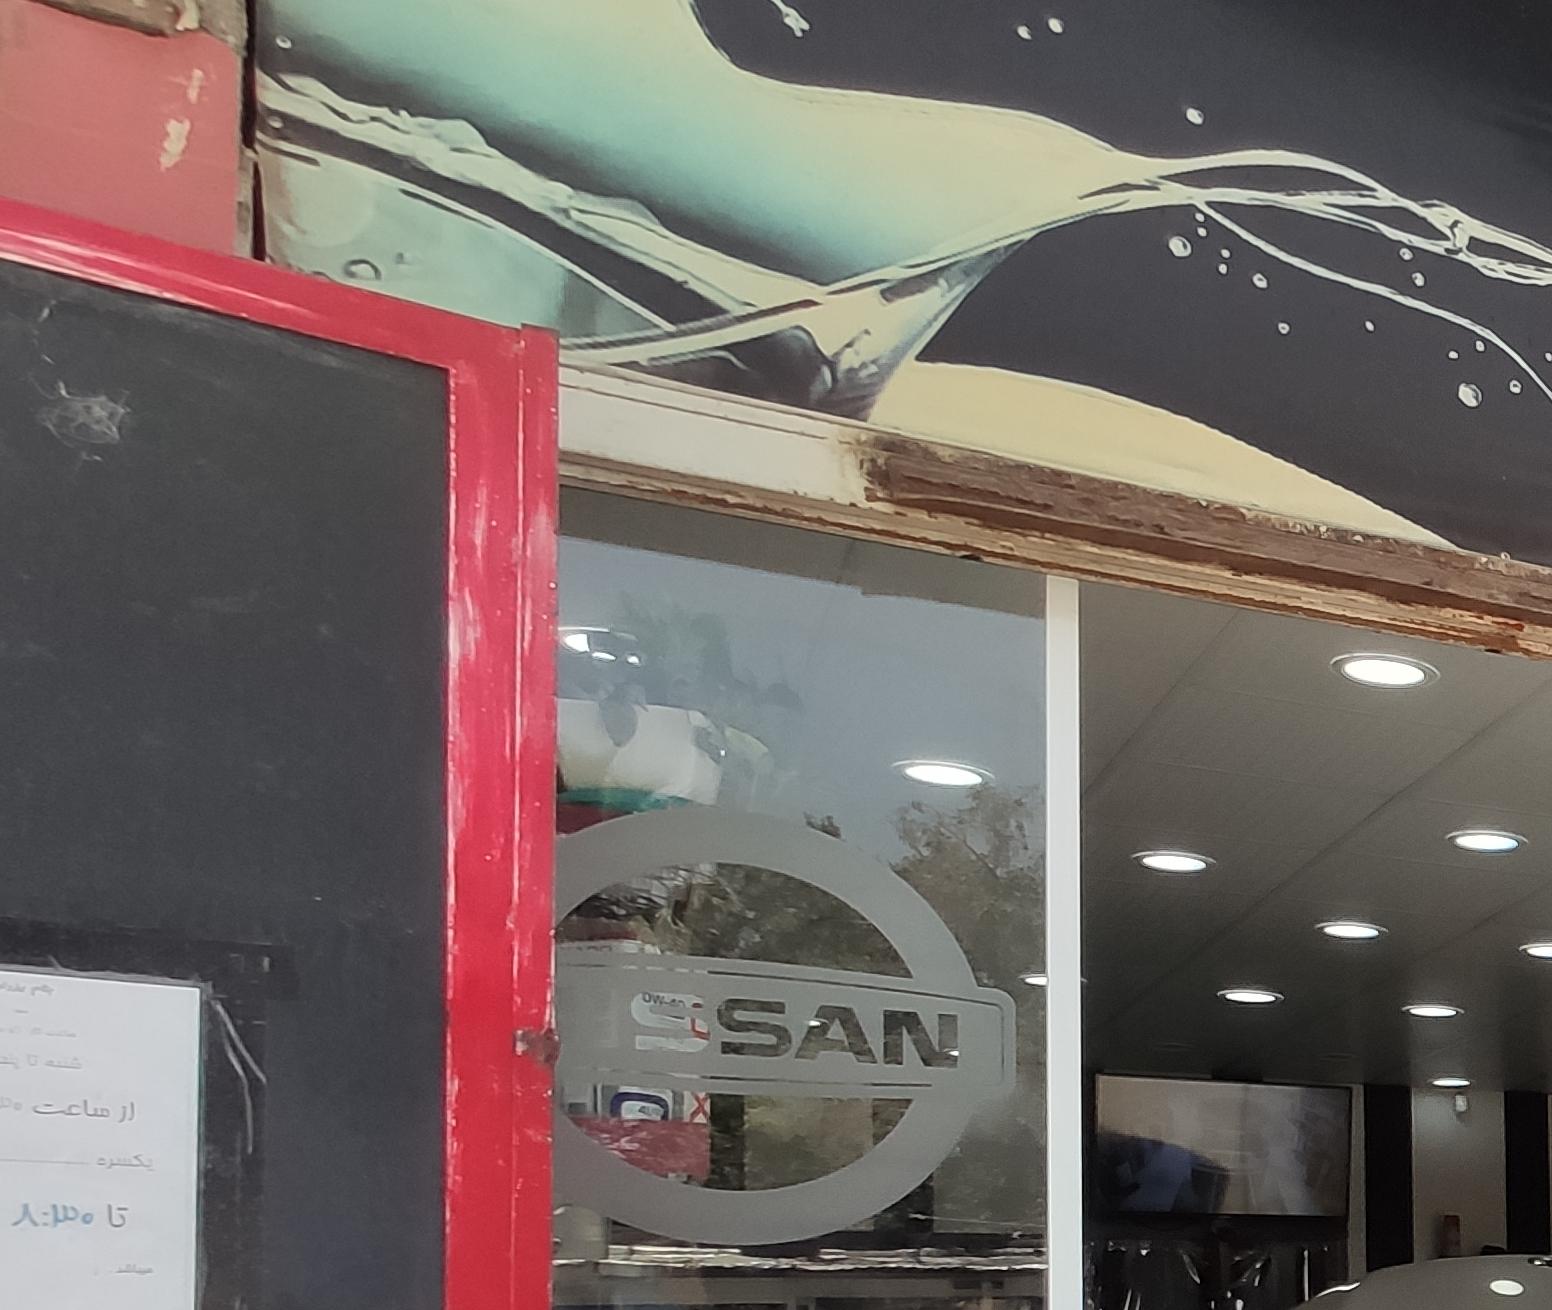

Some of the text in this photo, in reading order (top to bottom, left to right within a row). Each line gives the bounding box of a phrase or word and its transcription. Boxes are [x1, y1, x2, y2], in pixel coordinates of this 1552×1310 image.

[31, 1097, 112, 1120] ساعت
[117, 1100, 137, 1125] از
[95, 1152, 156, 1173] یکسره
[106, 1202, 130, 1230] تا
